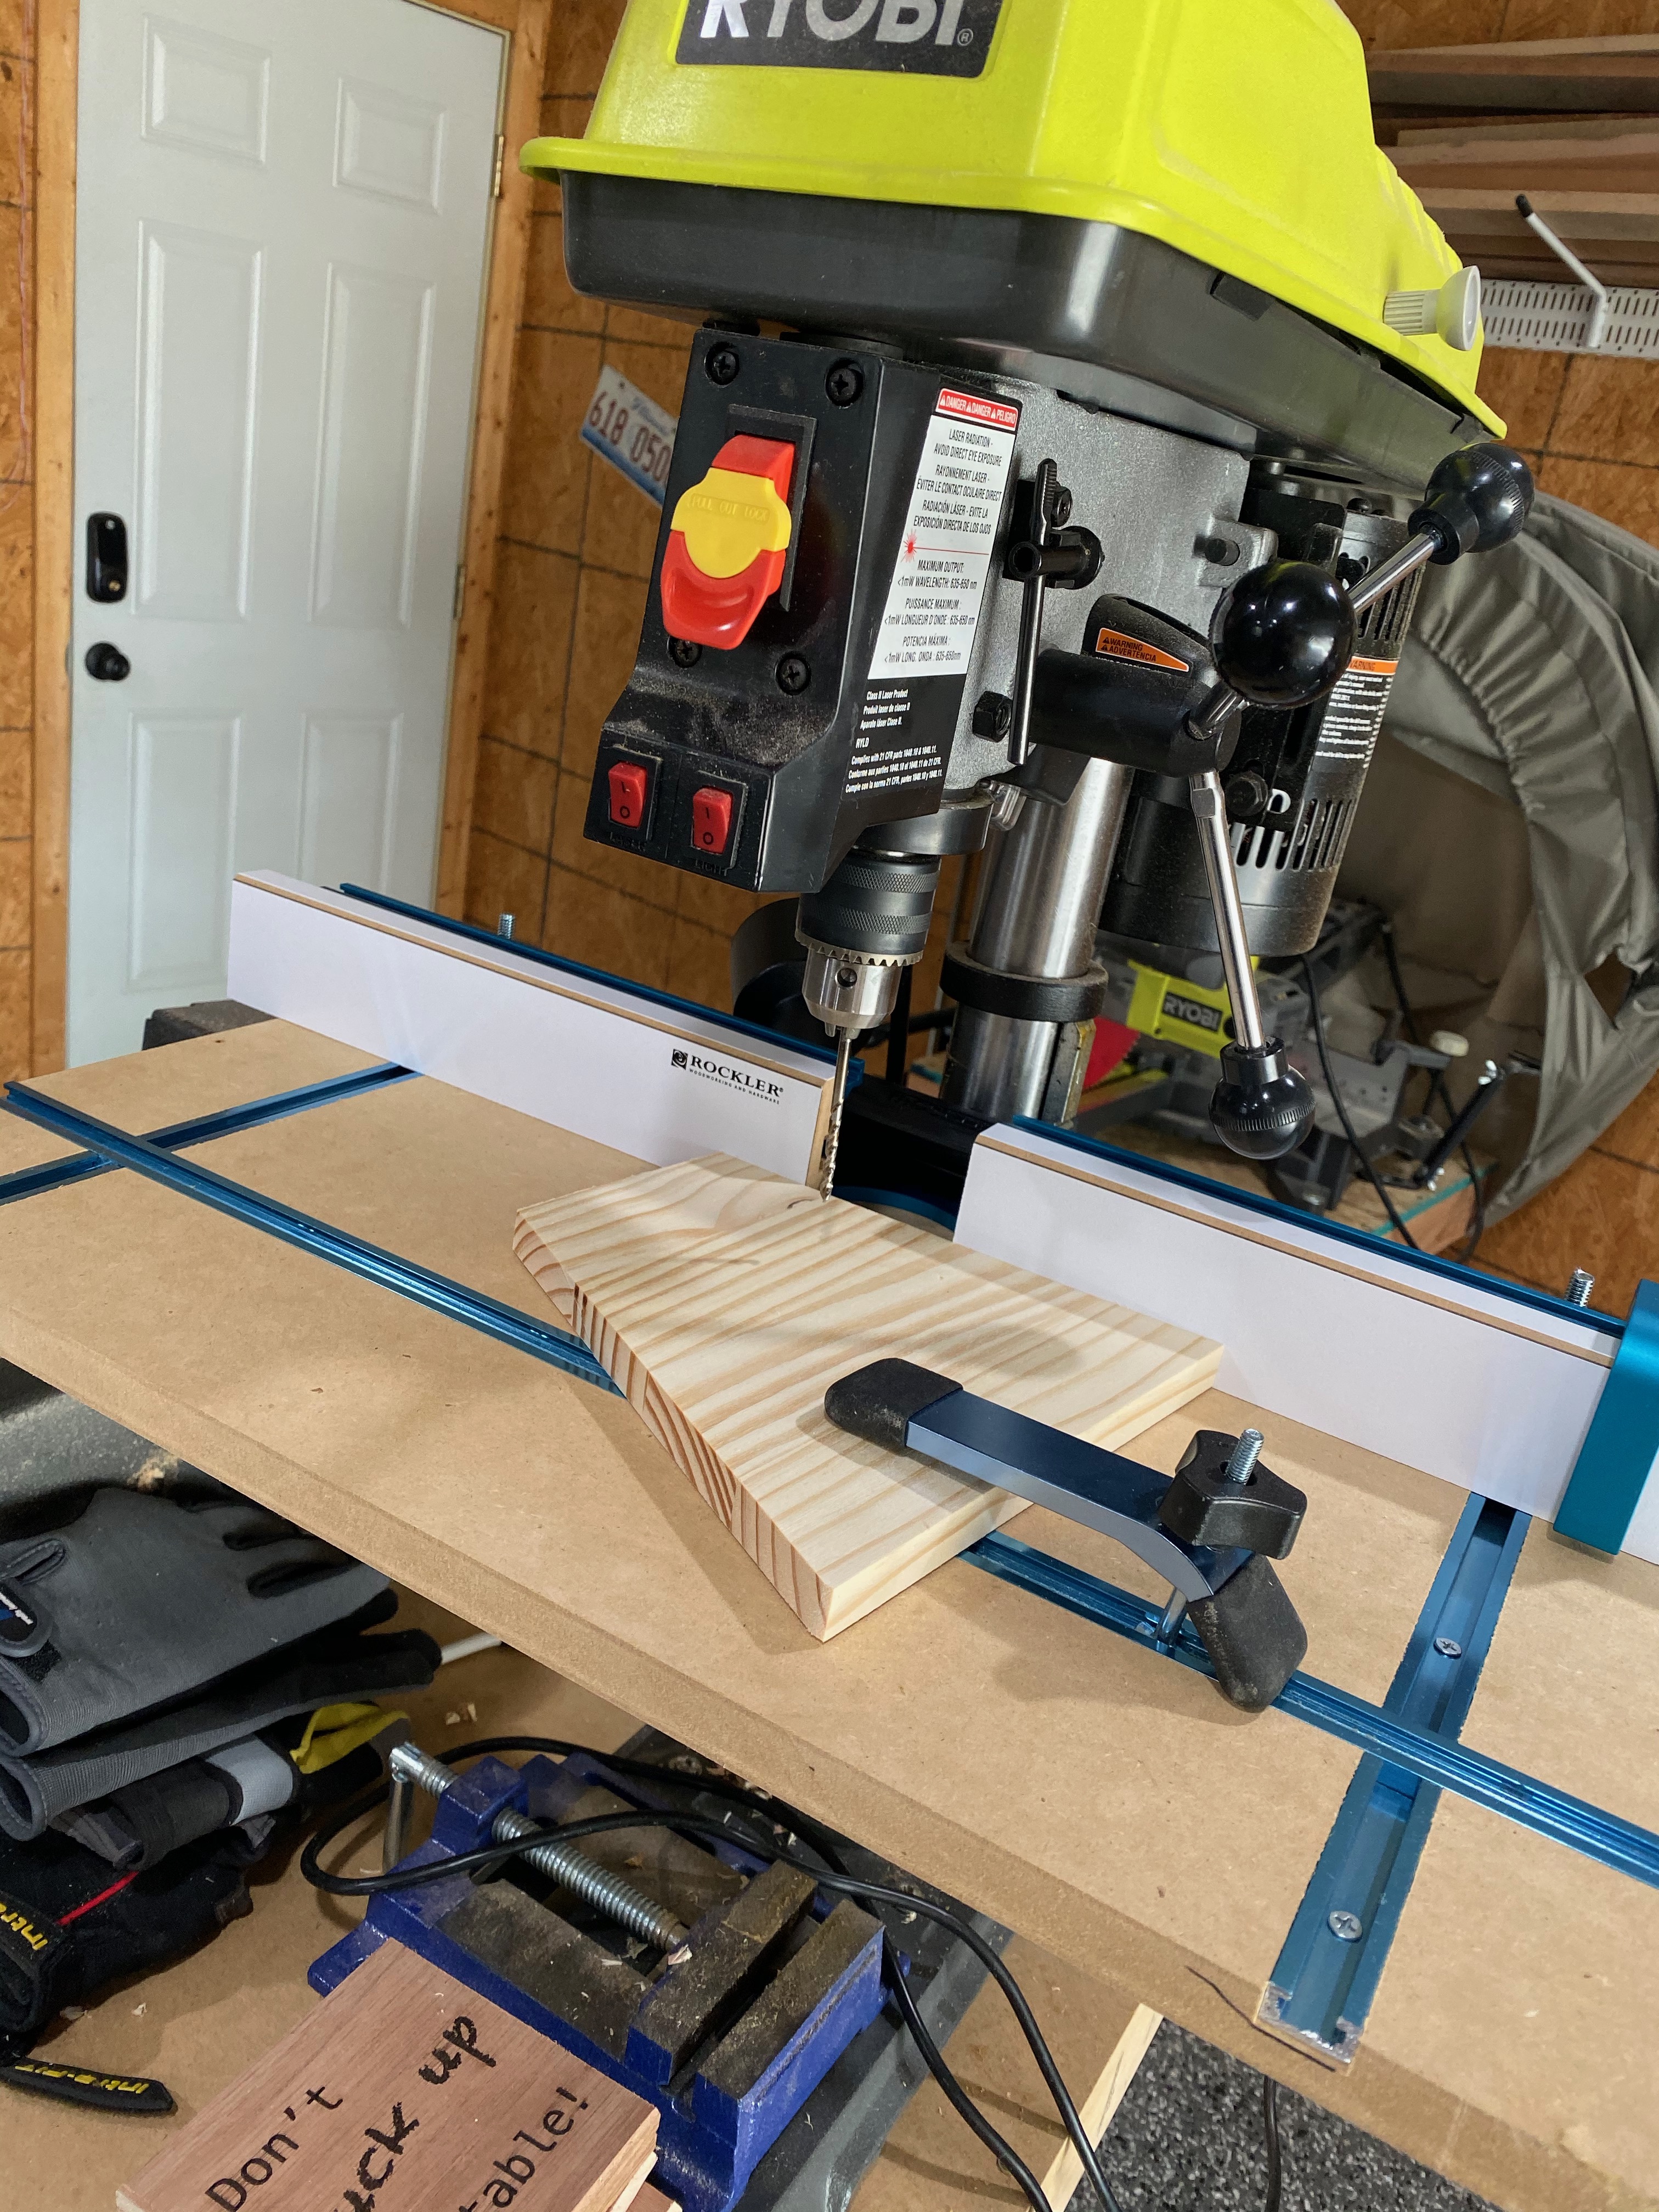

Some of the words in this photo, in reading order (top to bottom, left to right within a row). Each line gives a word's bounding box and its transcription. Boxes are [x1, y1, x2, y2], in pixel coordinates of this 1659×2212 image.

[589, 391, 629, 445] 618
[946, 396, 967, 410] DANGER
[972, 403, 991, 417] DANGER
[996, 410, 1016, 424] PELIGRO
[949, 429, 964, 442] LASER
[966, 432, 990, 448] RADIATION
[934, 443, 950, 455] AVOID
[950, 447, 968, 460] DIRECT
[968, 450, 977, 461] EYE
[978, 452, 1002, 466] EXPOSURE
[935, 465, 972, 481] RAYONNEMENT
[972, 471, 987, 483] LASER
[935, 481, 941, 493] LE
[942, 483, 963, 495] CONTACT
[963, 486, 985, 499] OCULAIRE
[985, 490, 1002, 501] DIRECT
[922, 500, 950, 514] RADIACIÓN
[950, 501, 966, 516] LÁSER
[969, 506, 982, 517] EVITE
[982, 509, 988, 518] LA
[913, 515, 943, 529] EXPOSICIÓN
[943, 520, 962, 531] DIRECTA
[963, 522, 969, 532] DE
[969, 522, 979, 533] LOS
[979, 523, 991, 534] OJOS
[917, 560, 944, 572] MAXIMUM
[944, 562, 964, 573] OUTPUT:
[916, 576, 950, 588] WAVELENGTH:
[951, 578, 969, 589] 635-650
[969, 581, 977, 589] nm
[905, 598, 934, 609] PUISSANCE
[901, 614, 928, 625] LONGUEUR
[950, 615, 968, 625] 635-650
[902, 636, 927, 646] POTENCIA
[1110, 638, 1143, 651] WARNING
[1109, 645, 1156, 662] ADVERTENCIA
[867, 691, 878, 701] Class
[882, 691, 893, 699] Laser
[893, 689, 908, 698] Product
[864, 706, 878, 715] Produit
[889, 704, 894, 713] de
[894, 704, 906, 712] classe
[860, 720, 876, 731] Aparato
[887, 718, 898, 727] Clase
[855, 737, 870, 748] RYLD
[851, 755, 870, 765] Complies
[871, 753, 879, 762] with
[879, 752, 884, 761] 21
[885, 751, 893, 760] CFR
[893, 751, 903, 761] parts
[849, 770, 868, 779] Conforme
[875, 766, 889, 777] parties
[928, 758, 933, 766] 21
[845, 783, 861, 793] Cumple
[869, 781, 873, 789] la
[886, 777, 891, 786] 21
[900, 775, 912, 785] partes
[690, 1068, 732, 1087] WOODWORKING
[749, 1090, 780, 1105] HARDWARE
[418, 2016, 496, 2085] up
[205, 2086, 343, 2212] Don't
